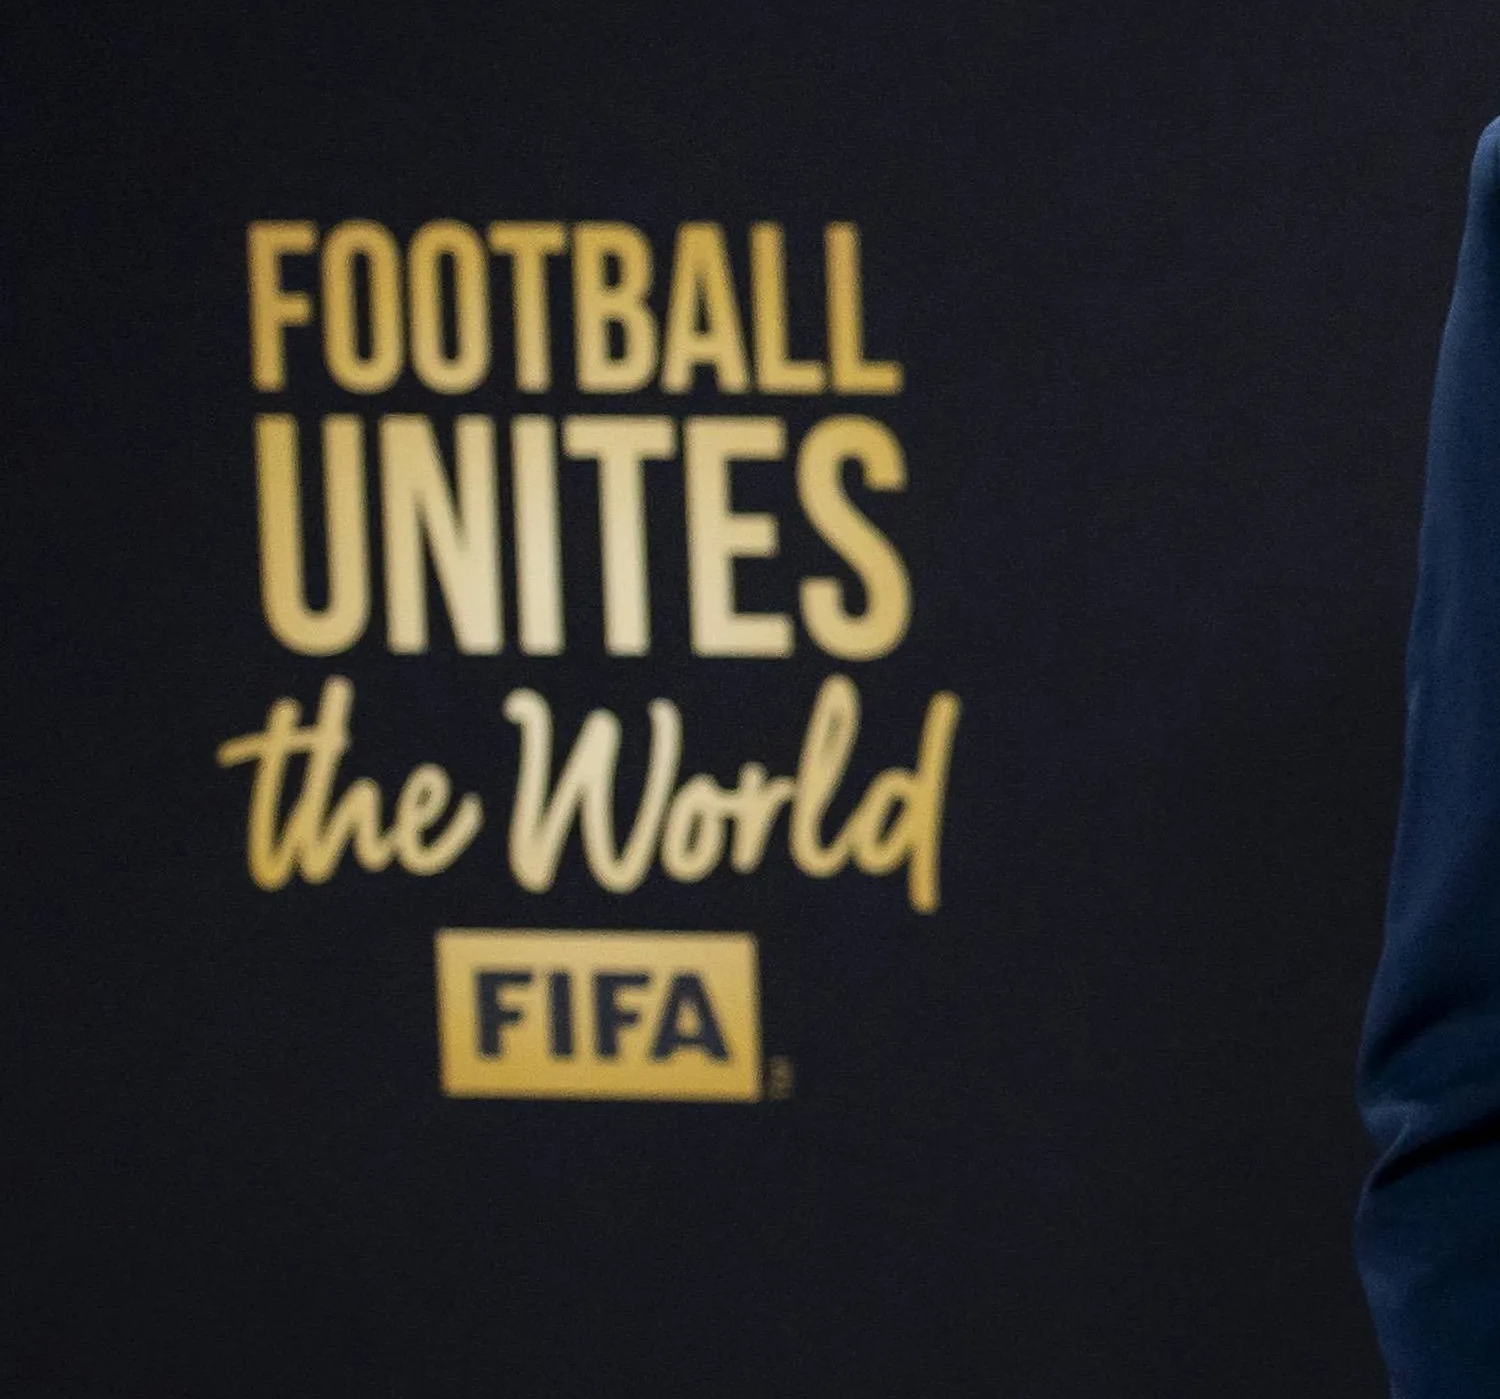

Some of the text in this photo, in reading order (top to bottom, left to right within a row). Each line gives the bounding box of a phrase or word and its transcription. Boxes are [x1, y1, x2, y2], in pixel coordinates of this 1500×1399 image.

[248, 220, 903, 395] FOOTBALL
[256, 413, 910, 661] UNITES
[217, 675, 959, 912] the World
[472, 967, 733, 1066] FIFA
